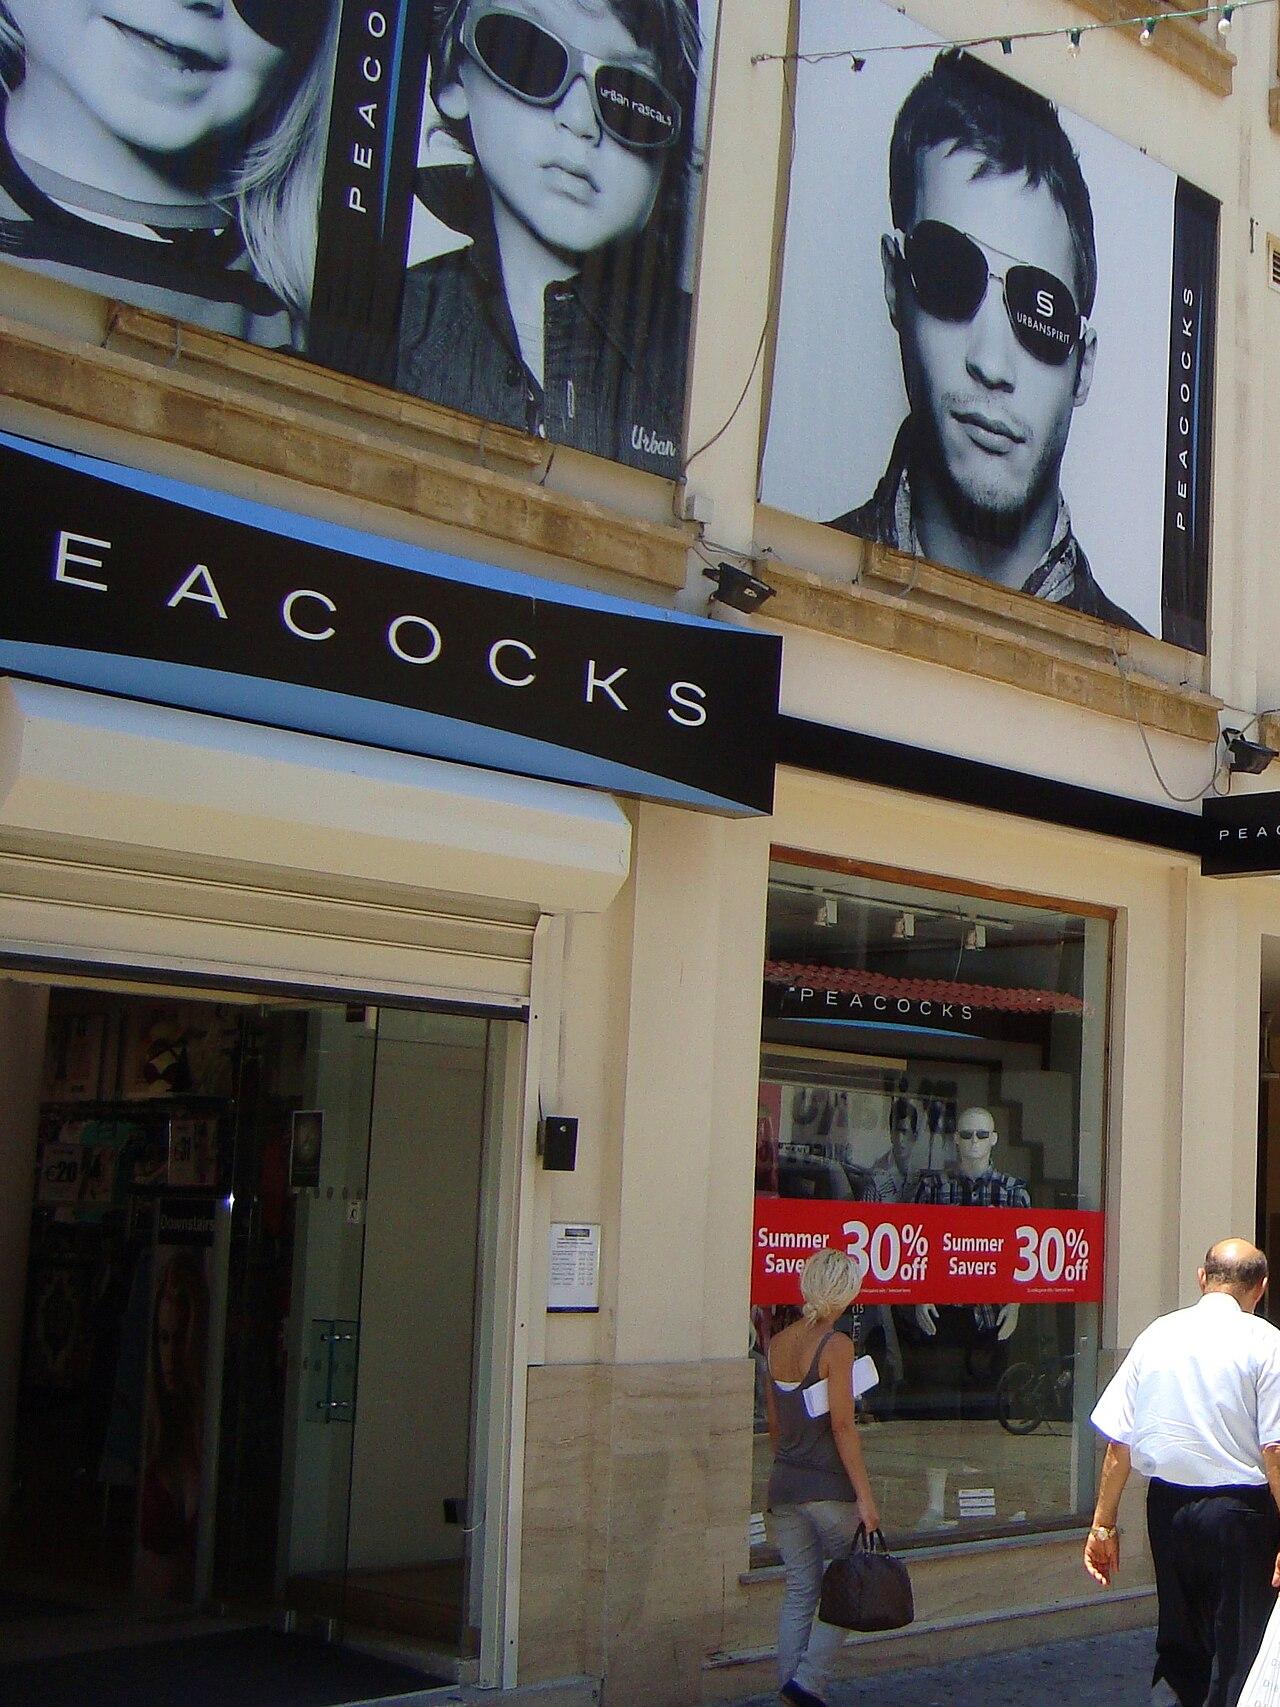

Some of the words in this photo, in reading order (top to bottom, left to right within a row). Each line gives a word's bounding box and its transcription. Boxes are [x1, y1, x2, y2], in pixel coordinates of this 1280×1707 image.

[1016, 312, 1070, 344] URBANSPIRIT
[1176, 287, 1194, 532] PEACOCKS
[631, 424, 677, 457] Urban
[799, 987, 973, 1020] PEACOCKS
[757, 1227, 830, 1249] Summer
[842, 1220, 929, 1282] 30%
[942, 1232, 1005, 1252] Summer
[764, 1253, 807, 1274] Save
[948, 1256, 997, 1275] Savers
[1013, 1225, 1089, 1282] 30%
[900, 1256, 929, 1281] off
[1064, 1258, 1089, 1281] off
